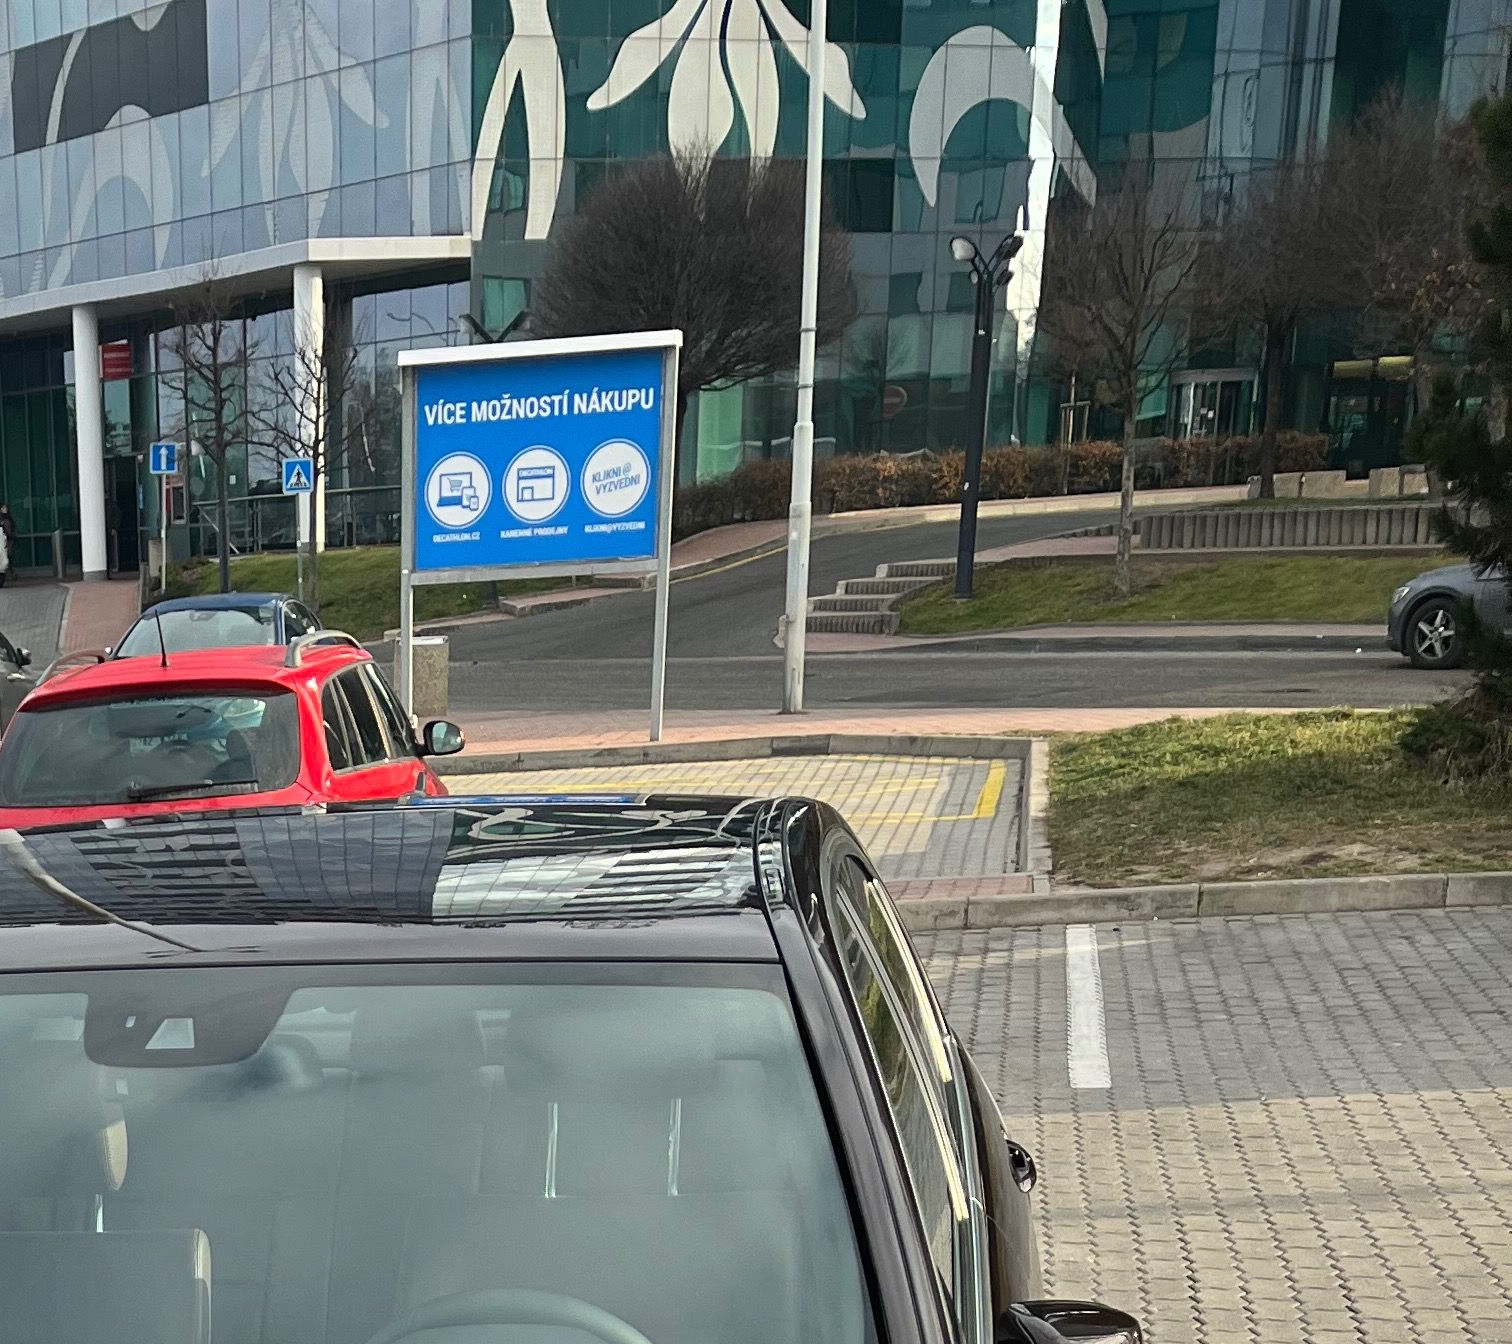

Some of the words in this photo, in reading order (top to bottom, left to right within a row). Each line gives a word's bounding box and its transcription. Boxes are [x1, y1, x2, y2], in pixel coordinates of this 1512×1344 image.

[424, 399, 466, 426] VÍCE
[472, 391, 568, 422] MOŽNOSTÍ
[574, 388, 654, 415] NÁKUPU
[592, 467, 622, 484] KLIKNI
[595, 475, 641, 495] VYZVEDNI
